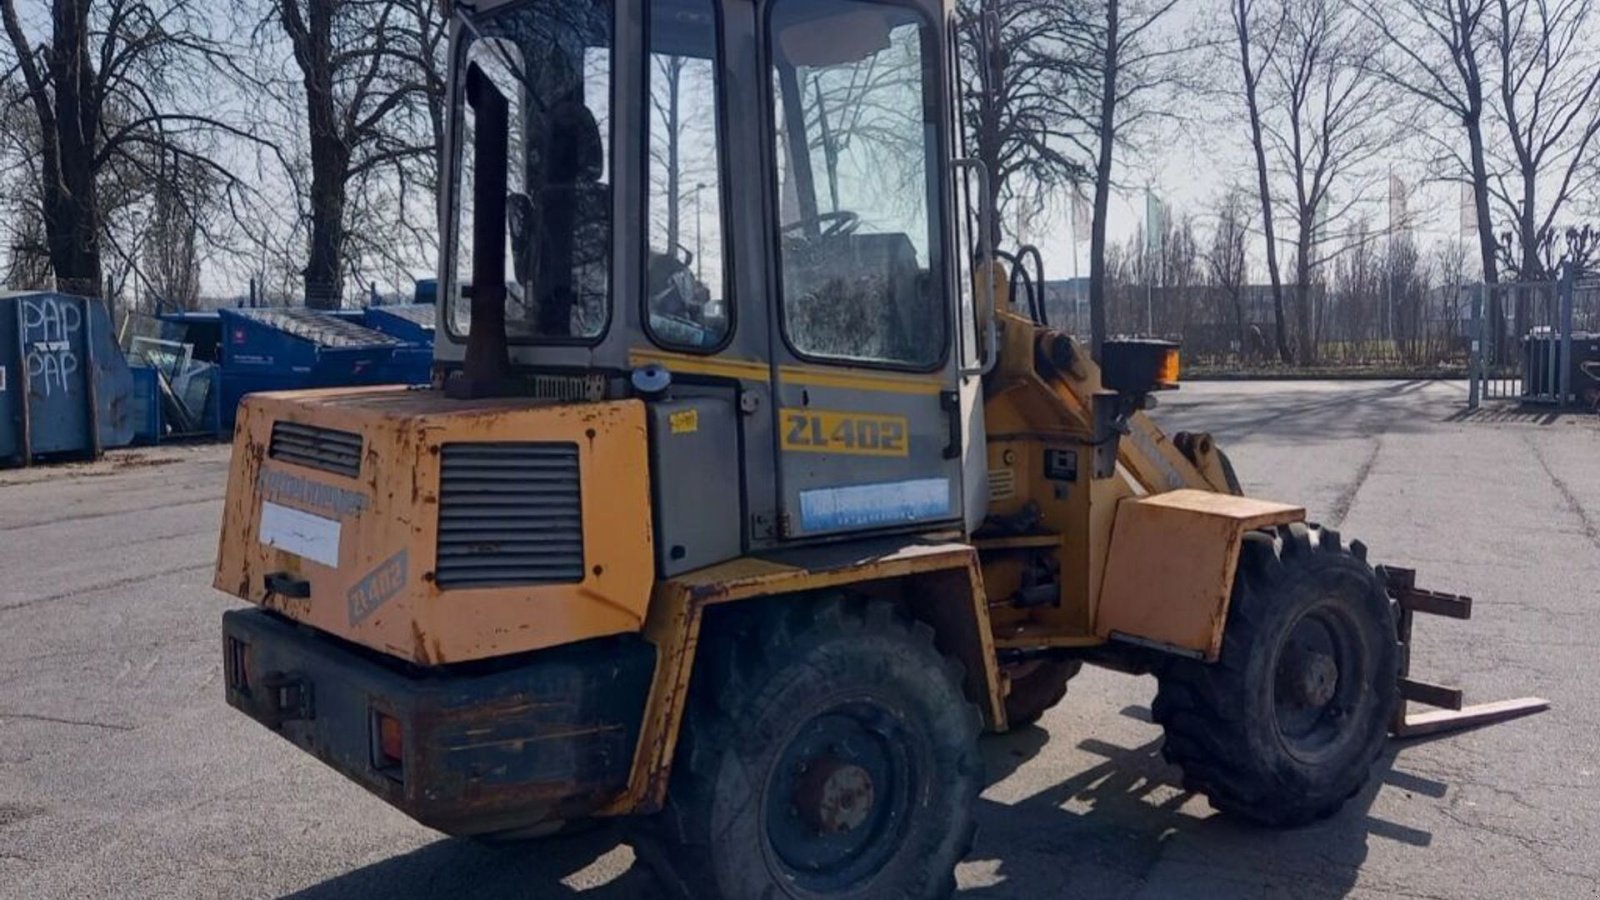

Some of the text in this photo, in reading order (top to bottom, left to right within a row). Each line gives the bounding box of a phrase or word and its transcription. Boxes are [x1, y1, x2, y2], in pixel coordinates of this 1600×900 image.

[22, 298, 81, 343] PAP
[27, 351, 78, 397] PAP
[786, 413, 905, 451] ZL402
[350, 561, 402, 617] ZL402
